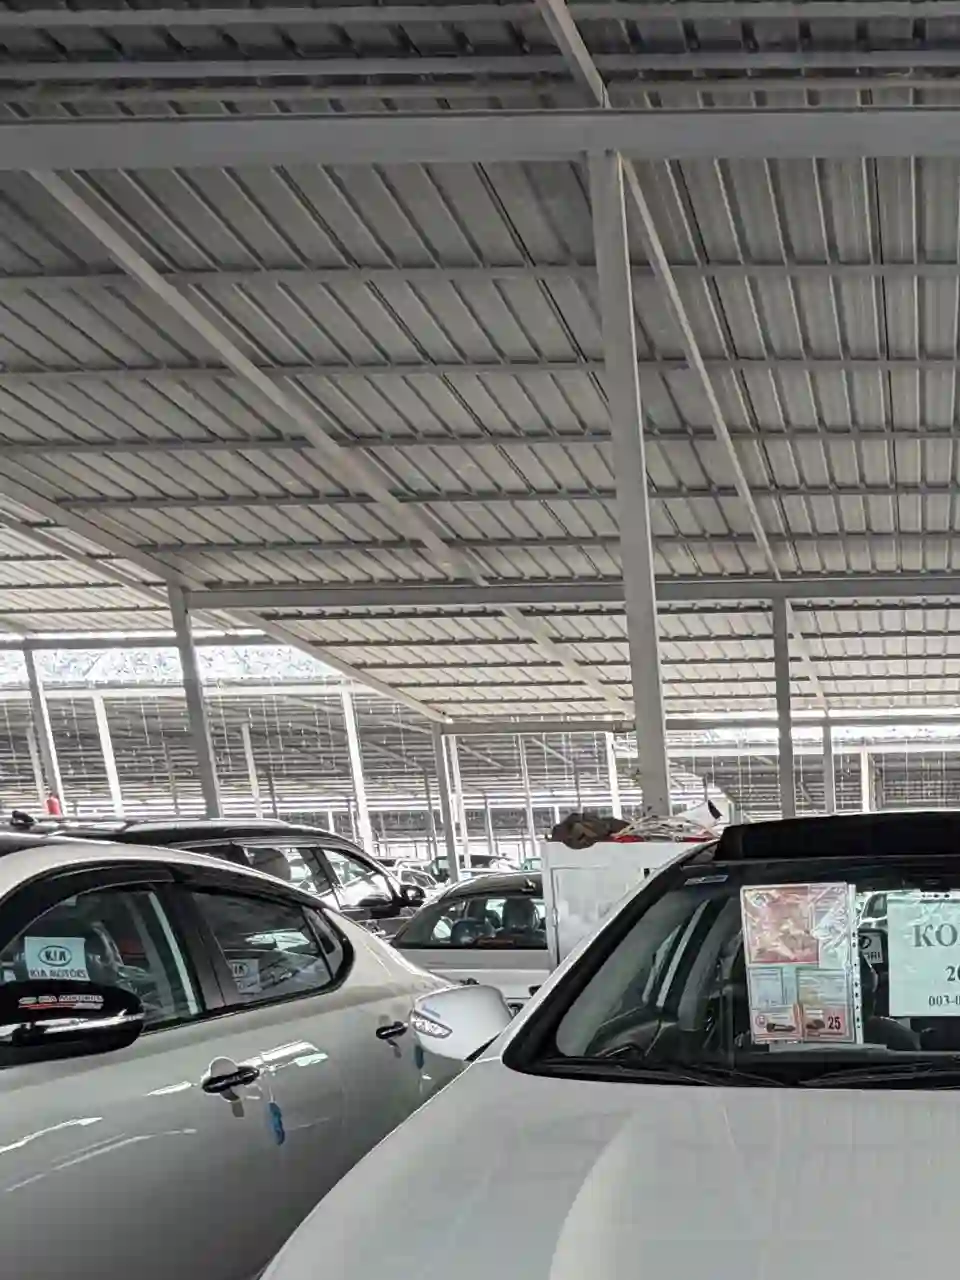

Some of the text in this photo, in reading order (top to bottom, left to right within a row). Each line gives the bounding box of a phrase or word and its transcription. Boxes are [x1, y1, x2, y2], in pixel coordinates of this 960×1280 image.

[45, 950, 67, 961] KIA
[29, 968, 48, 978] KIA
[827, 1016, 841, 1030] 25
